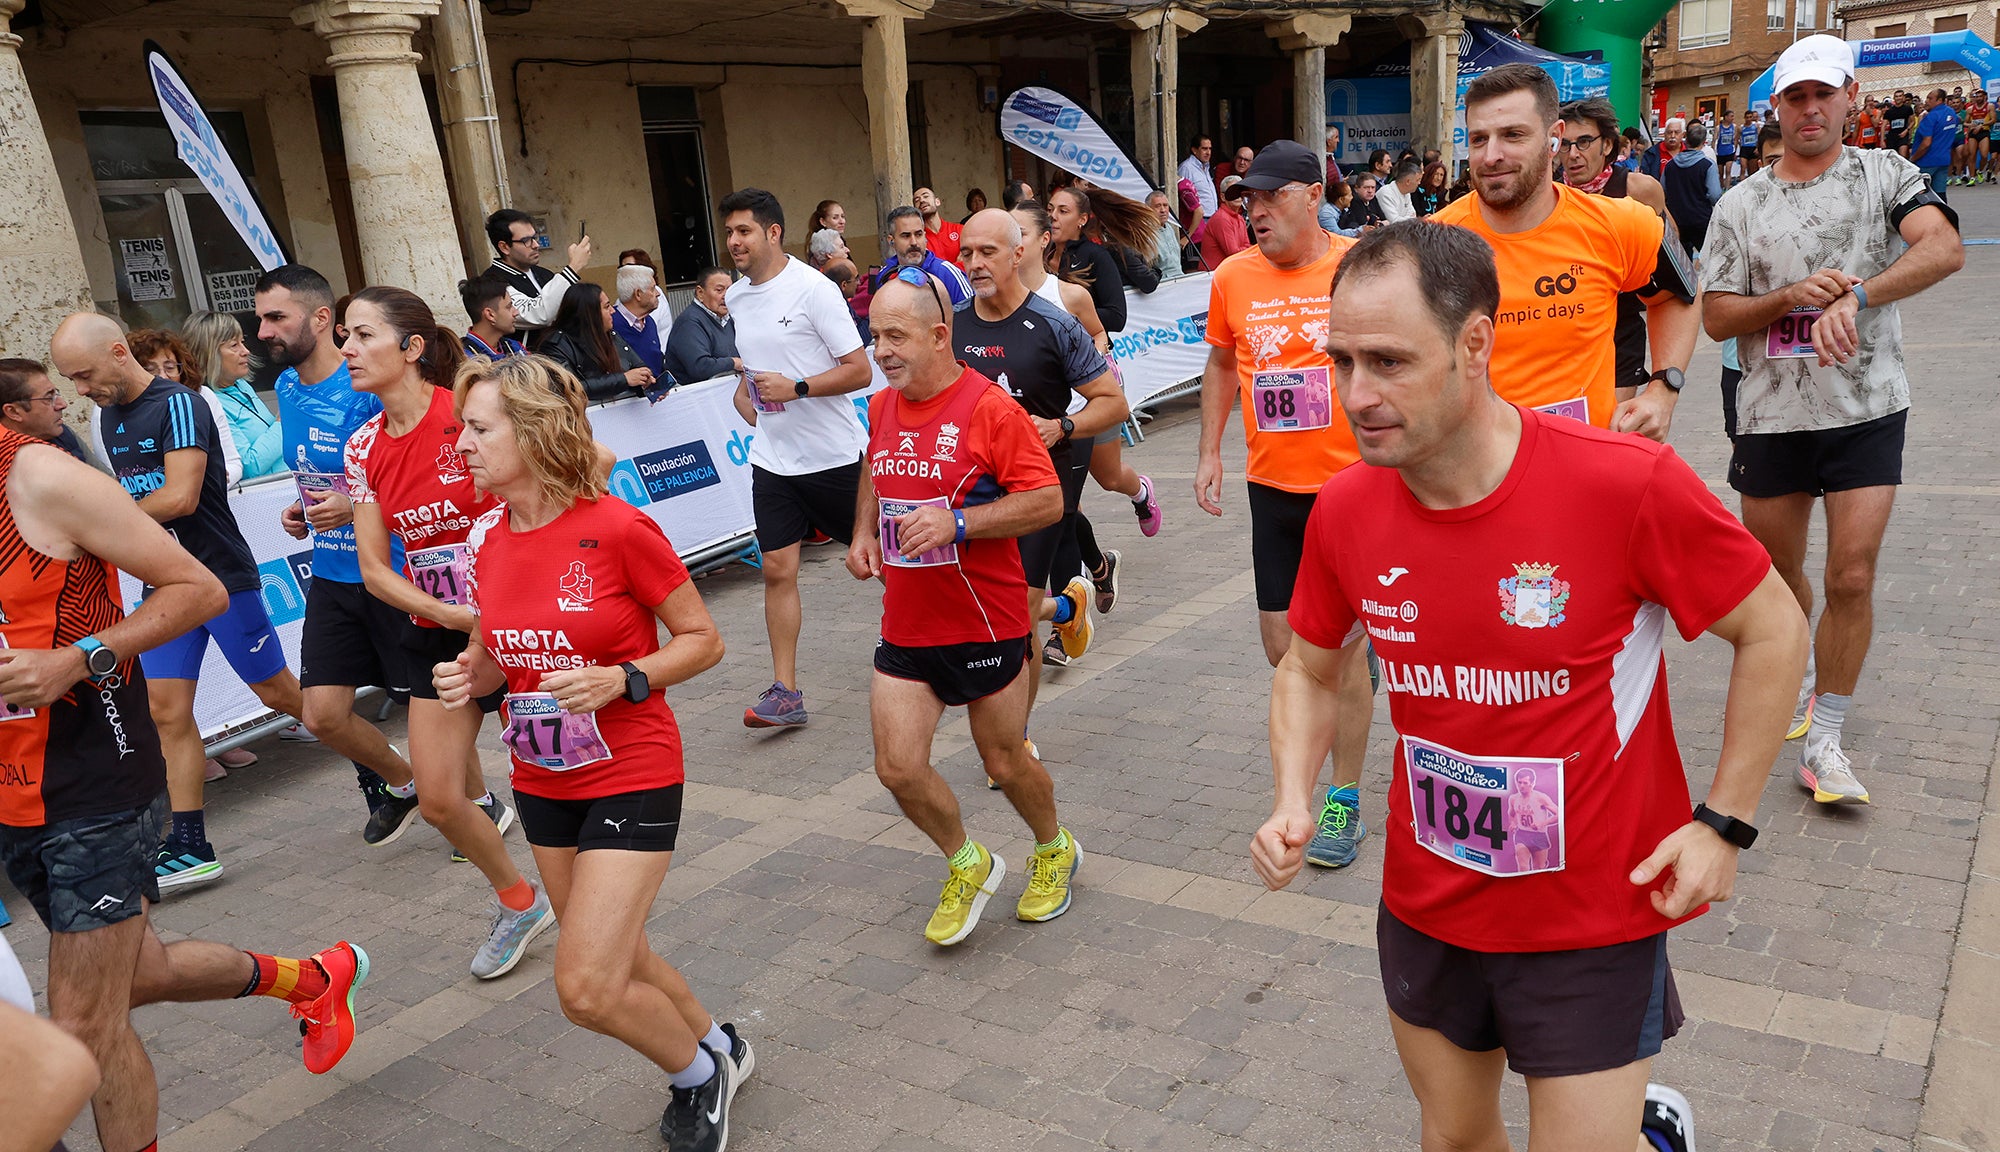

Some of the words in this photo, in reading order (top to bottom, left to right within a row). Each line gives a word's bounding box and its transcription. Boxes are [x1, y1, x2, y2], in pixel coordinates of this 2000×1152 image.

[1863, 40, 1917, 53] Diputación
[1862, 53, 1877, 63] DE
[1879, 49, 1928, 61] PALENCIA
[1960, 48, 1993, 72] deportes
[1347, 126, 1407, 140] Diputación
[1347, 142, 1362, 153] DE
[125, 239, 165, 253] TENIS
[129, 268, 171, 283] TENIS
[1569, 264, 1585, 276] fit
[212, 275, 227, 290] SE
[1534, 272, 1577, 298] GO
[213, 289, 232, 301] 655
[232, 288, 248, 299] 419
[217, 301, 234, 313] 671
[233, 299, 250, 311] 070
[1250, 298, 1286, 310] Media
[1547, 302, 1585, 320] days
[1245, 311, 1280, 322] Ciudad
[1282, 309, 1297, 317] de
[963, 344, 1006, 358] CORRER
[1263, 388, 1296, 419] 88
[640, 452, 697, 477] Diputación
[871, 458, 943, 480] CARCOBA
[648, 479, 666, 494] DE
[664, 465, 716, 490] PALENCIA
[392, 499, 460, 528] TROTA
[416, 565, 458, 600] 121
[1361, 598, 1399, 619] Allianz
[491, 628, 574, 651] TROTA
[966, 655, 1002, 669] astuy
[1454, 664, 1571, 706] RUNNING
[1421, 751, 1435, 761] Los
[1434, 753, 1475, 776] 10.000
[1420, 758, 1462, 781] MARIANO
[1463, 774, 1499, 789] HARO
[1416, 774, 1509, 851] 184
[1520, 814, 1534, 827] 50
